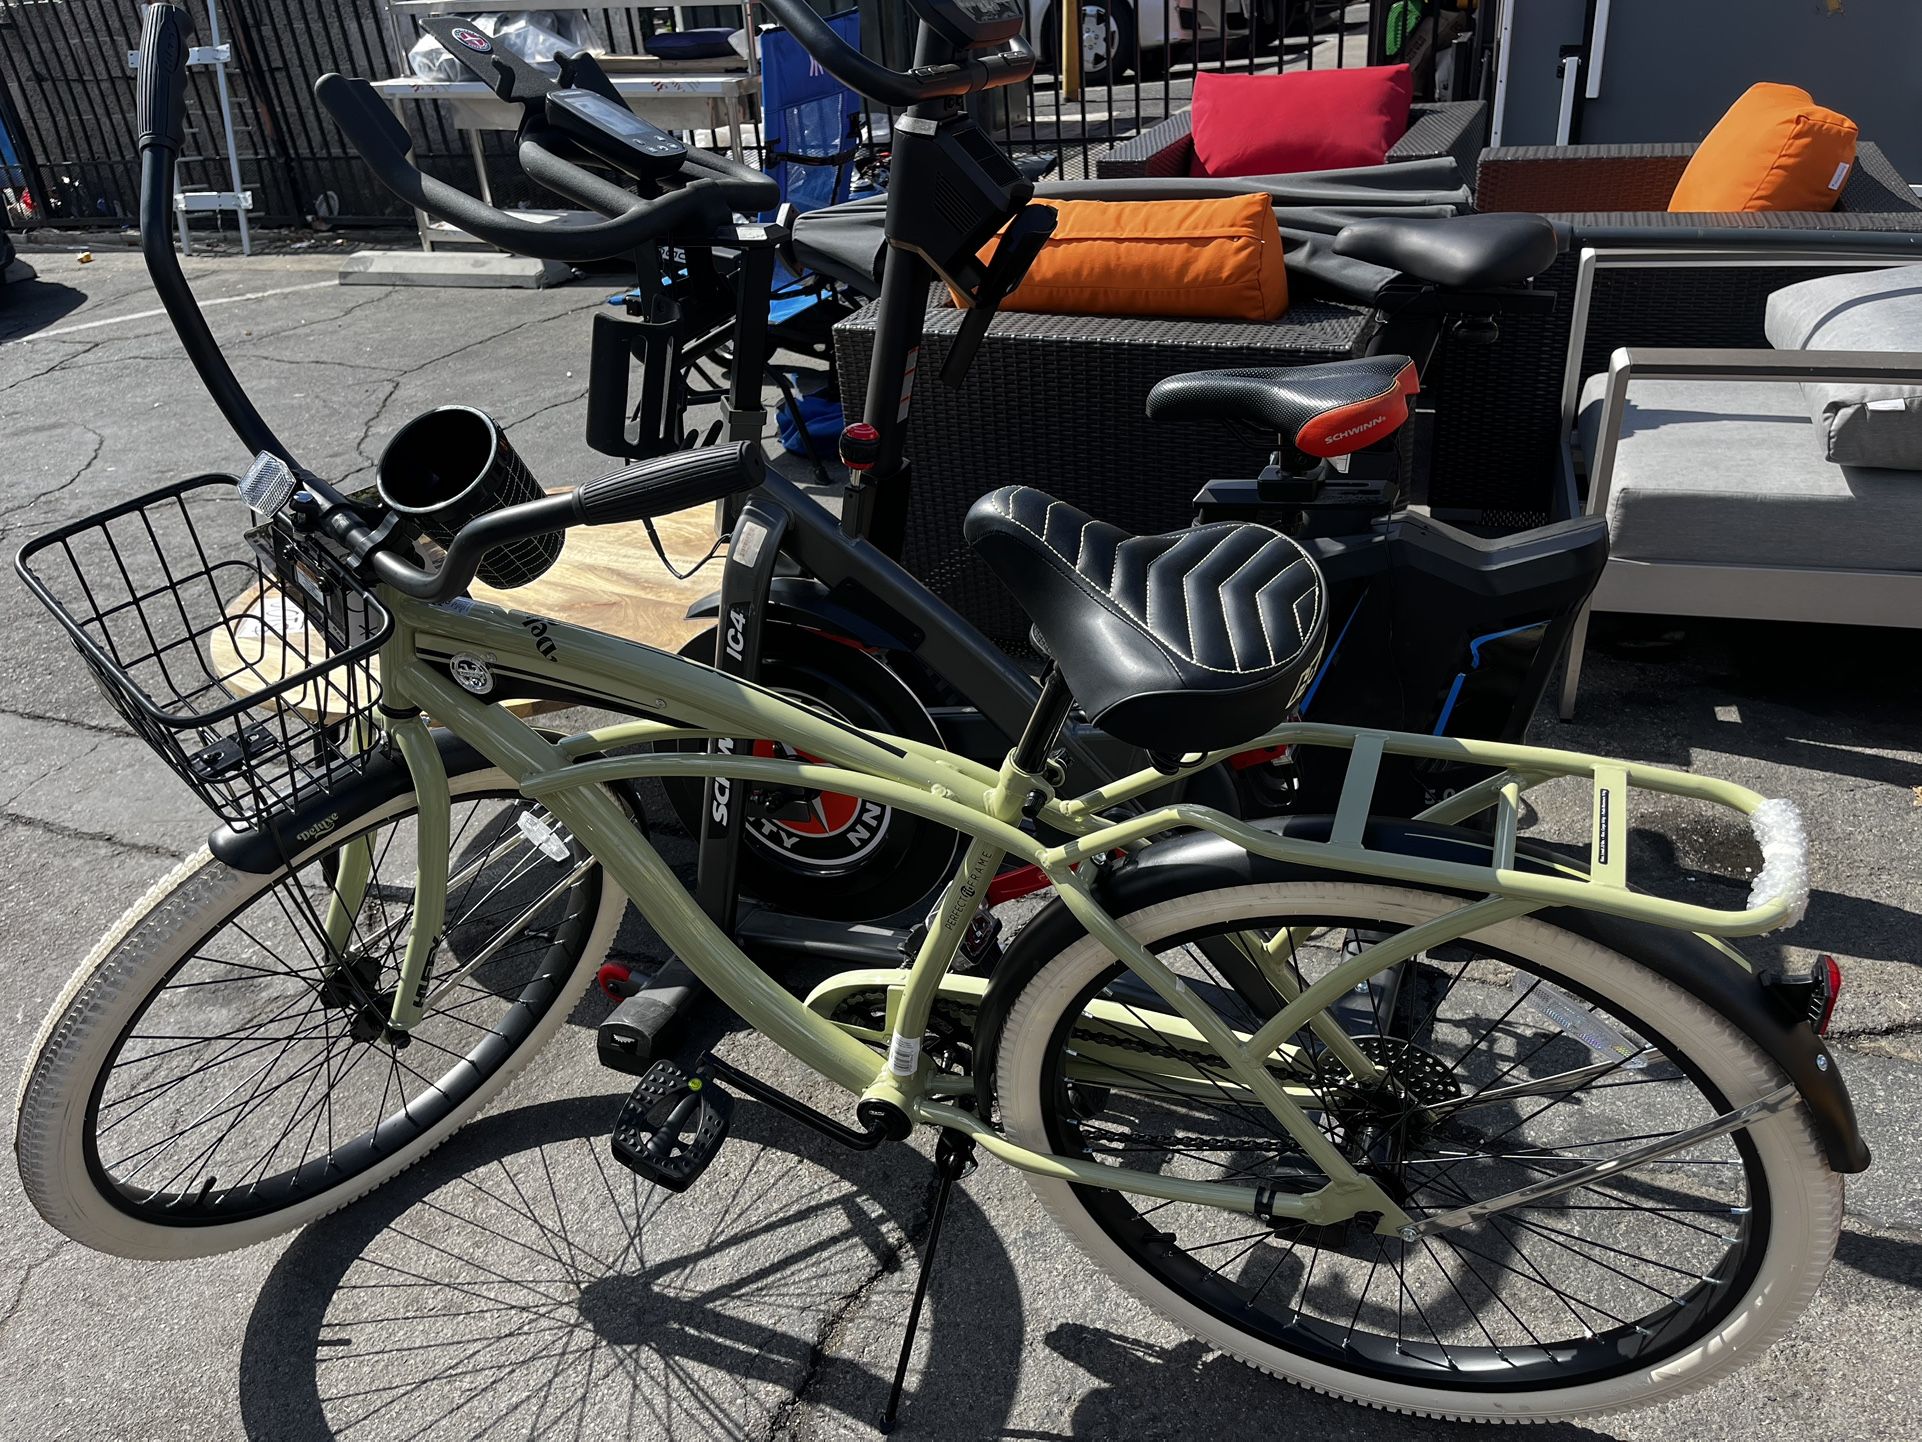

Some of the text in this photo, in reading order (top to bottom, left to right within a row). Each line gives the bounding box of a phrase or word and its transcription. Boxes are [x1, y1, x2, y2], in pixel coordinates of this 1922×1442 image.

[1325, 415, 1383, 444] SCHWINN
[522, 616, 559, 663] Del
[726, 609, 746, 661] IC4
[296, 812, 339, 842] Deluxe
[945, 896, 968, 930] PERFECT
[967, 851, 992, 888] FRAME
